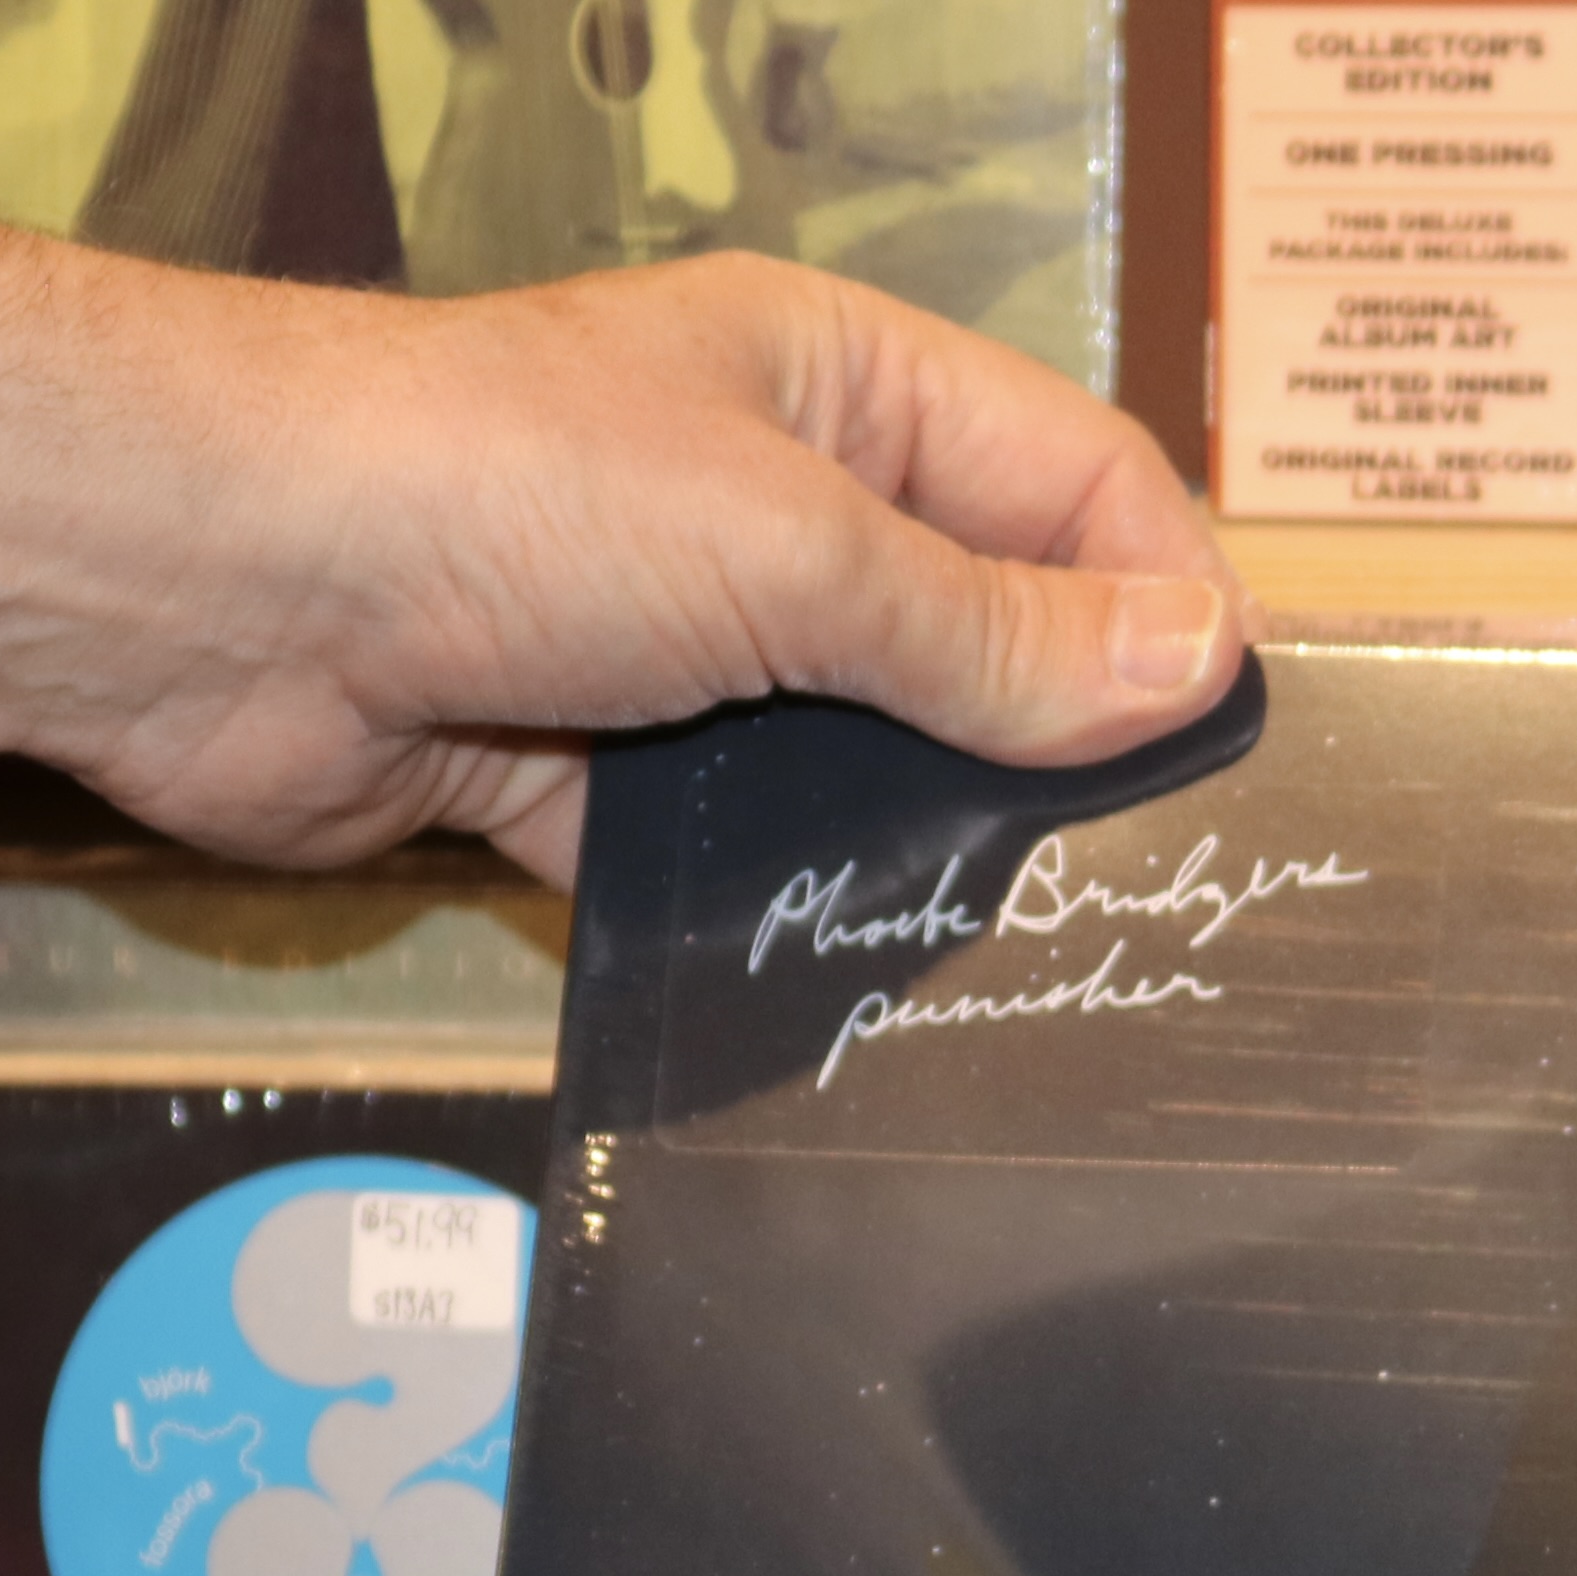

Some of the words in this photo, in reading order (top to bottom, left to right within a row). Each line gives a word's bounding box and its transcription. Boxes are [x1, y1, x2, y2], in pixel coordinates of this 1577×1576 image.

[1294, 32, 1545, 59] COLLECTOR'S
[1345, 68, 1493, 93] EDITION
[1285, 141, 1360, 166] ONE
[1371, 141, 1554, 167] PRESSING
[1398, 211, 1513, 233] DELUXE
[1269, 241, 1403, 262] PACKAGE
[1336, 296, 1499, 321] ORIGINAL
[1320, 326, 1436, 349] ALBUM
[1450, 326, 1517, 349] ART
[1288, 371, 1431, 396] PRINTED
[1446, 371, 1549, 396] INNER
[1353, 401, 1481, 424] SLEEVE
[1262, 448, 1420, 473] ORIGINAL
[1436, 448, 1574, 474] RECORD
[1352, 478, 1482, 502] LABELS
[748, 855, 980, 975] Phoebe
[996, 833, 1368, 949] Bridgers
[816, 939, 1221, 1091] punisher
